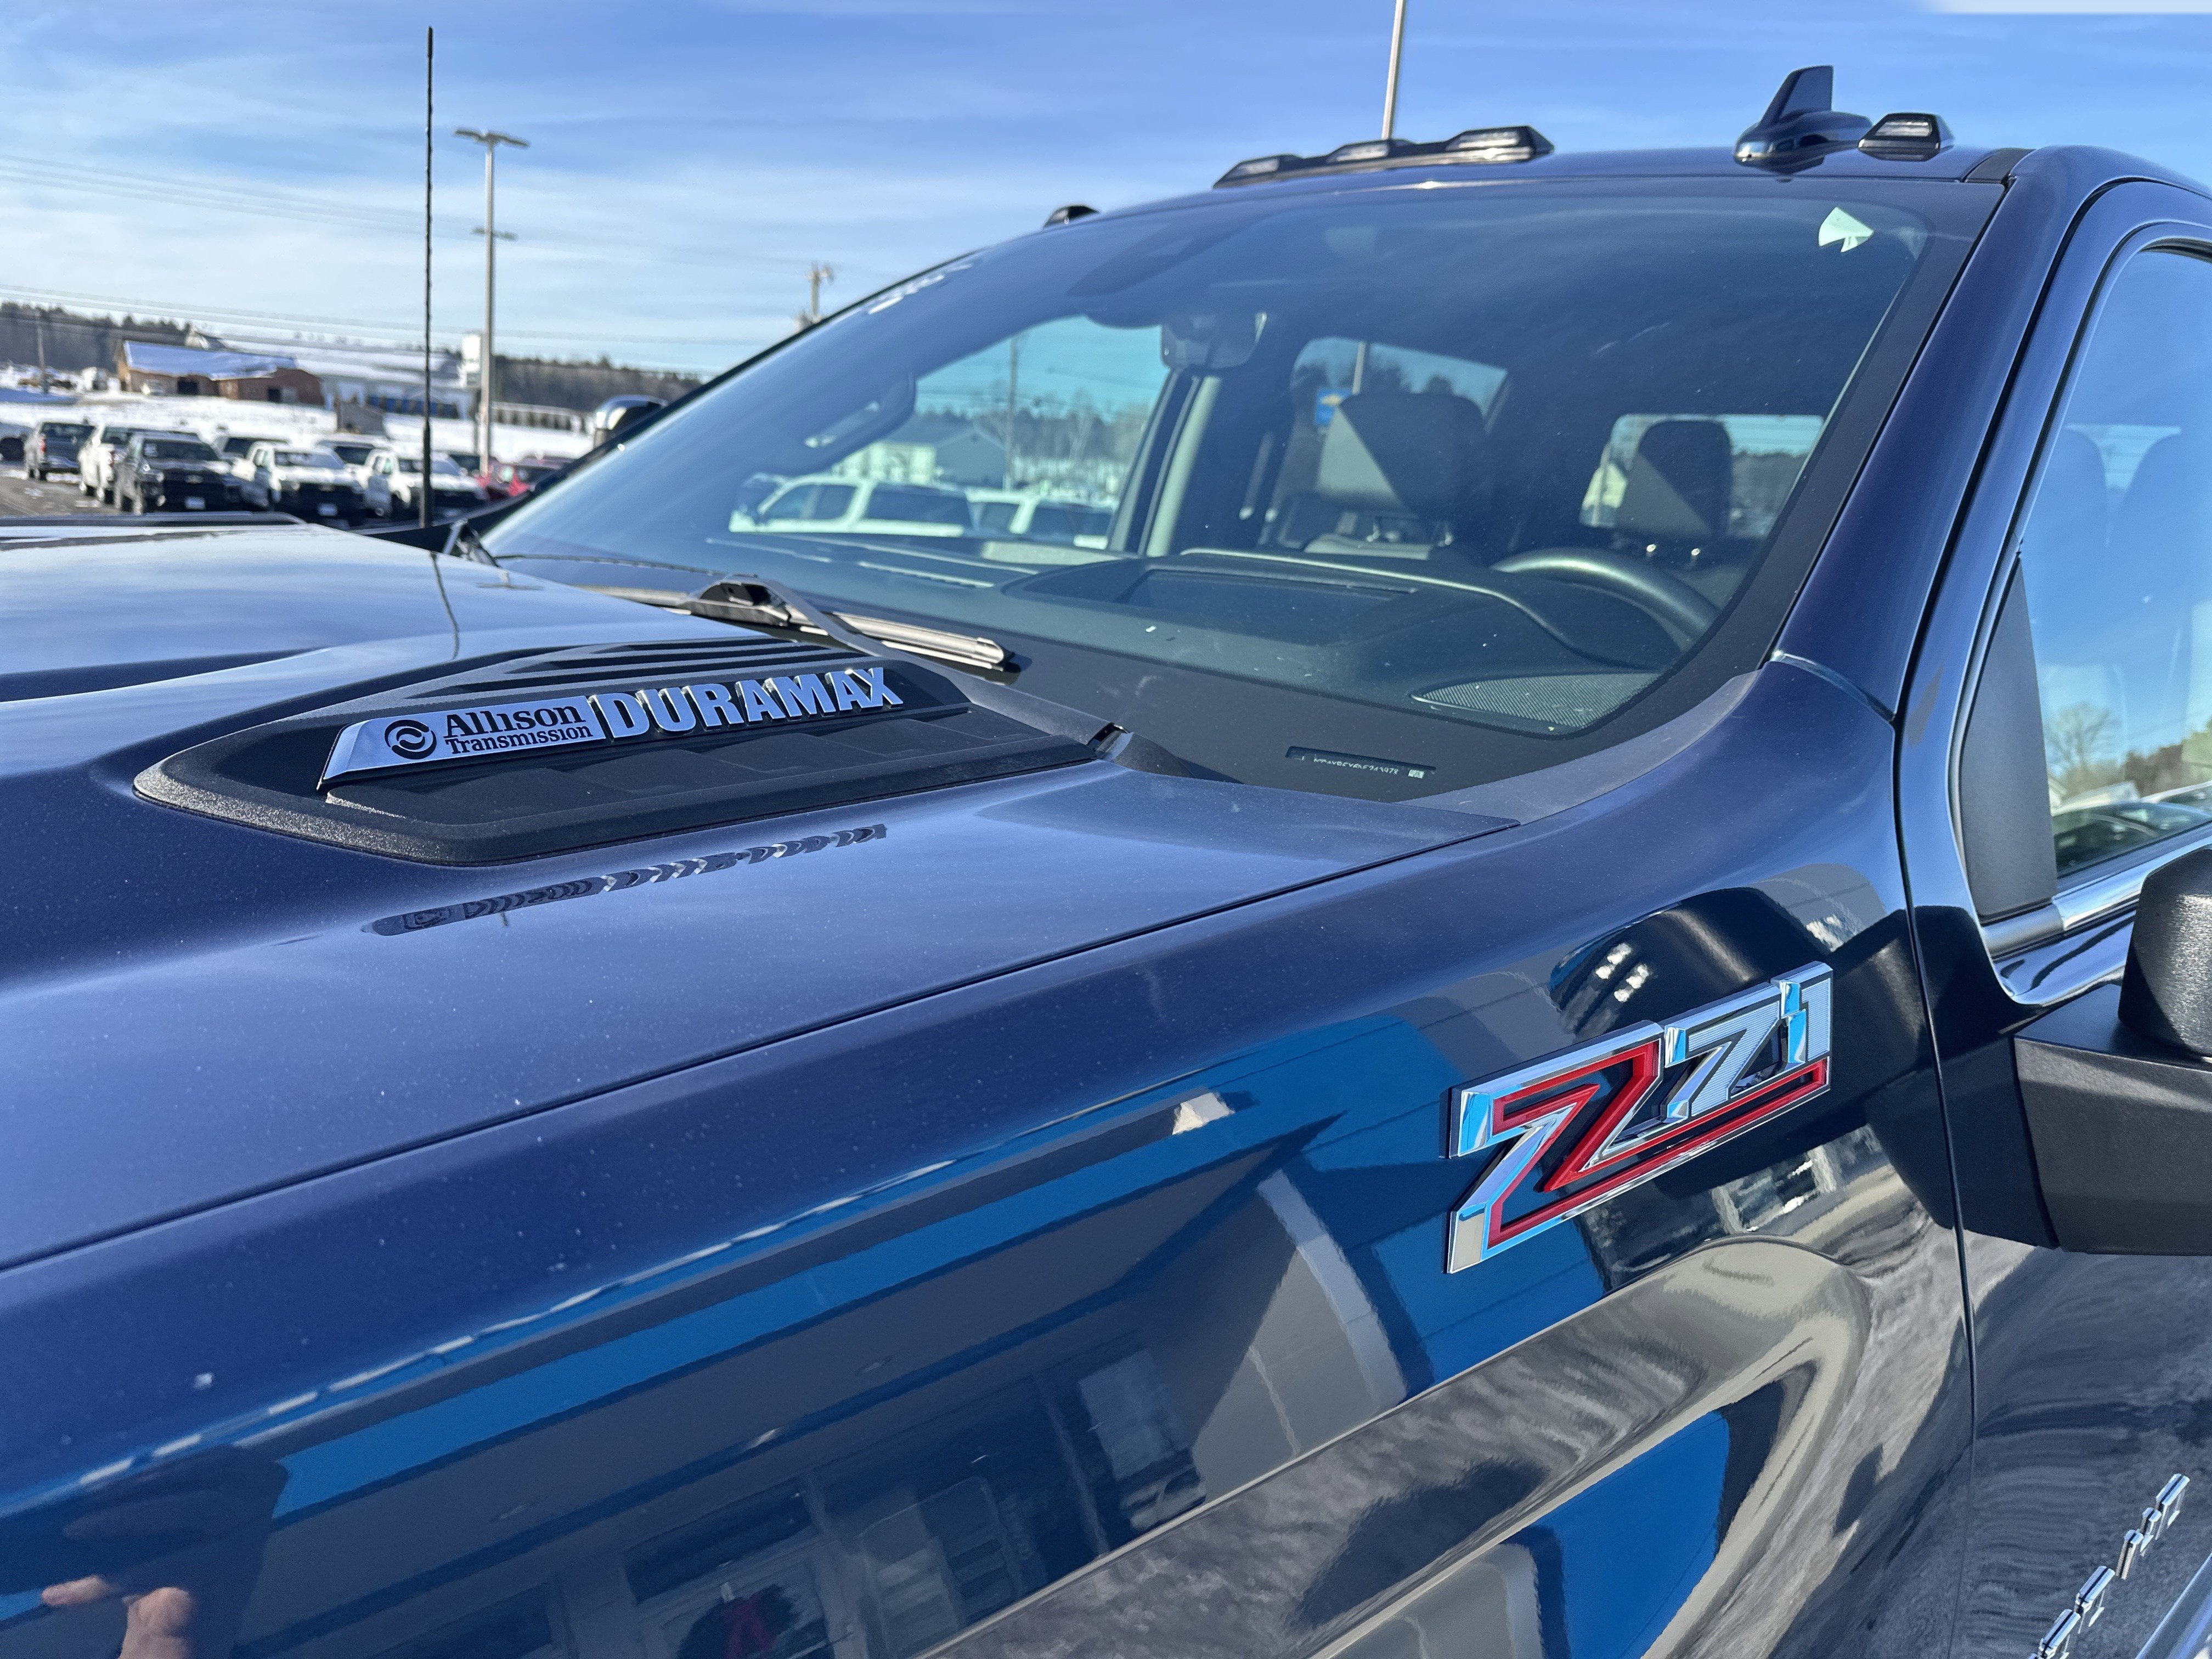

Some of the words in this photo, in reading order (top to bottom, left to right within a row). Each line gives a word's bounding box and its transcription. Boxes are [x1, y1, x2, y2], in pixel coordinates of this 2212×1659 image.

[444, 706, 586, 738] Allison
[595, 667, 904, 739] DURAMAX
[445, 726, 593, 754] Transmission
[1446, 961, 1833, 1274] Z71
